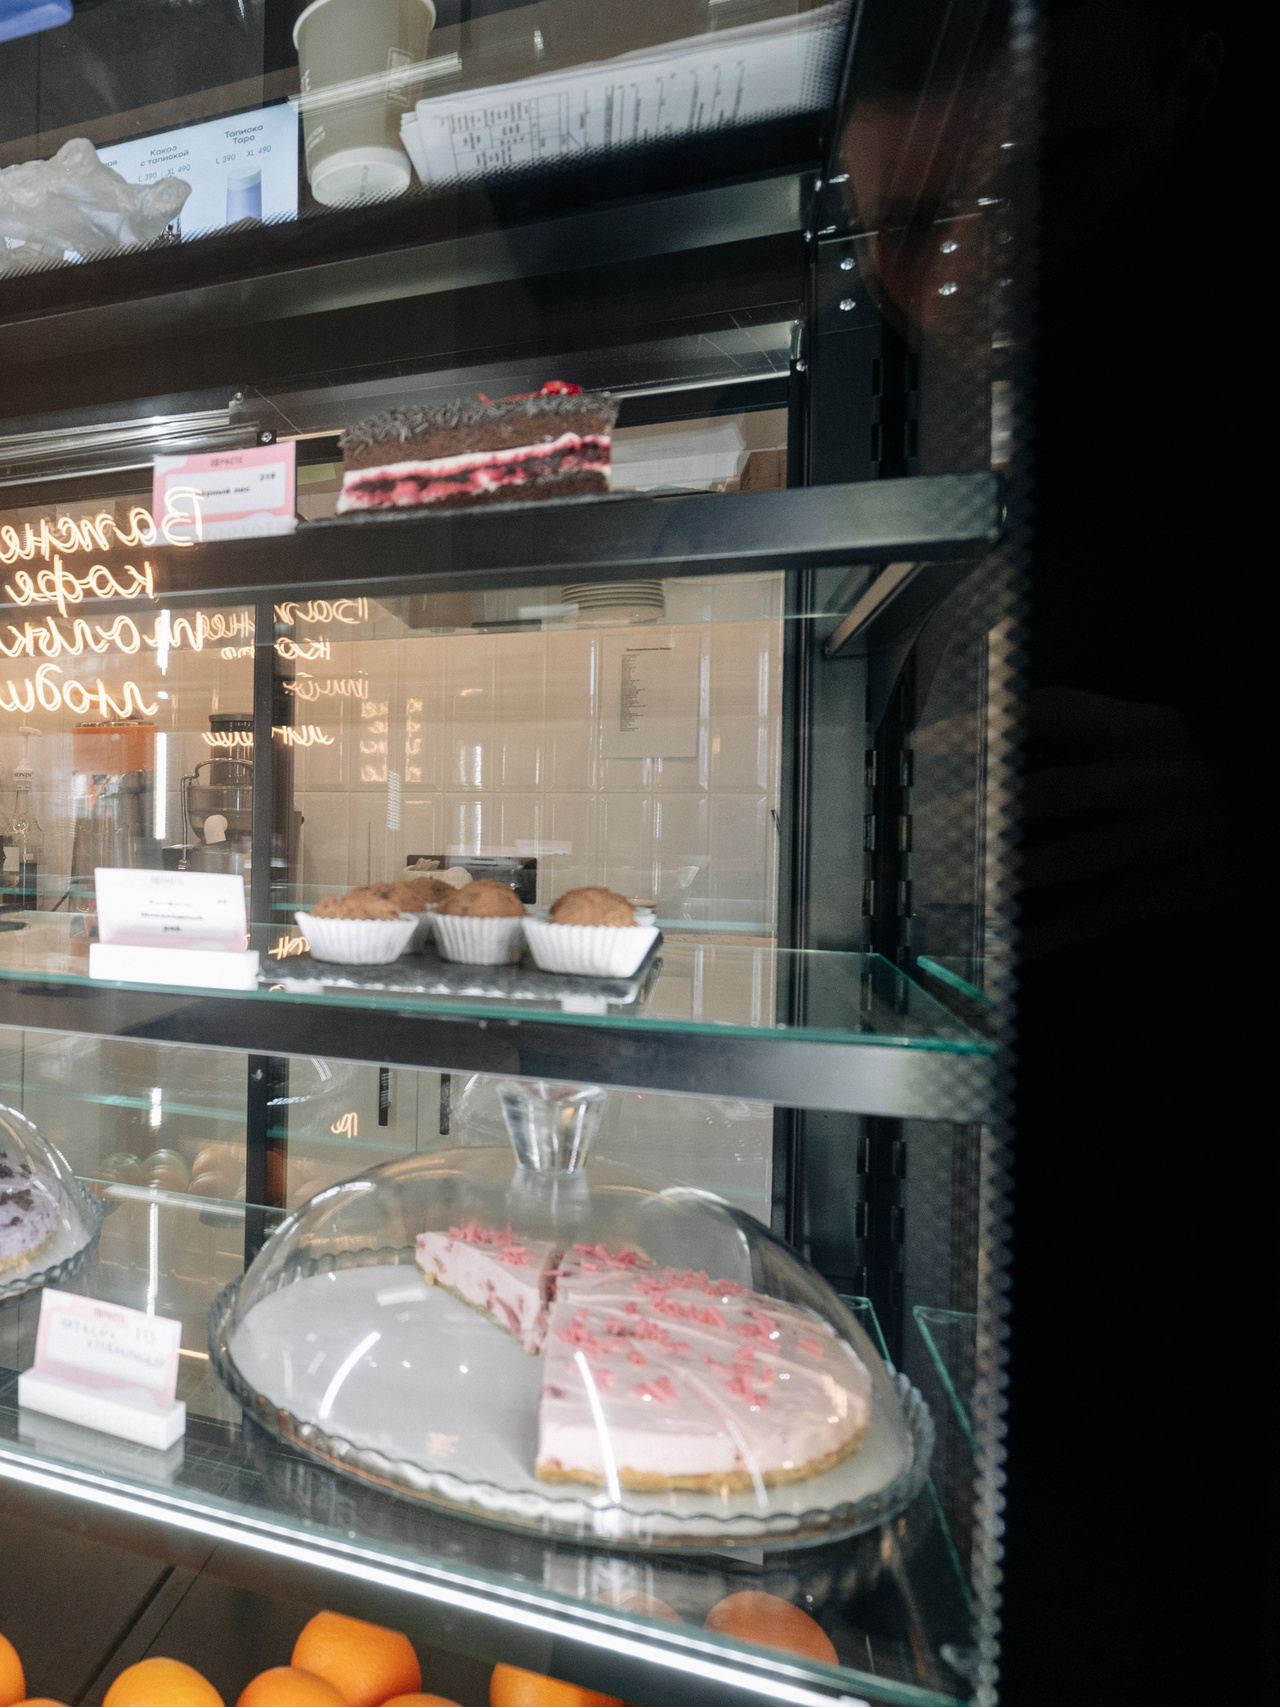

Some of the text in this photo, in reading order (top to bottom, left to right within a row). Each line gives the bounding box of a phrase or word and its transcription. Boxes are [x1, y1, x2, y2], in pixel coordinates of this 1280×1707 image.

[225, 124, 264, 138] Тапиока
[232, 135, 255, 146] Таро
[148, 150, 189, 166] тапиокой
[150, 145, 178, 157] Какао
[222, 153, 236, 163] 390
[258, 145, 272, 155] 490
[144, 172, 157, 181] 390
[177, 164, 191, 173] 490
